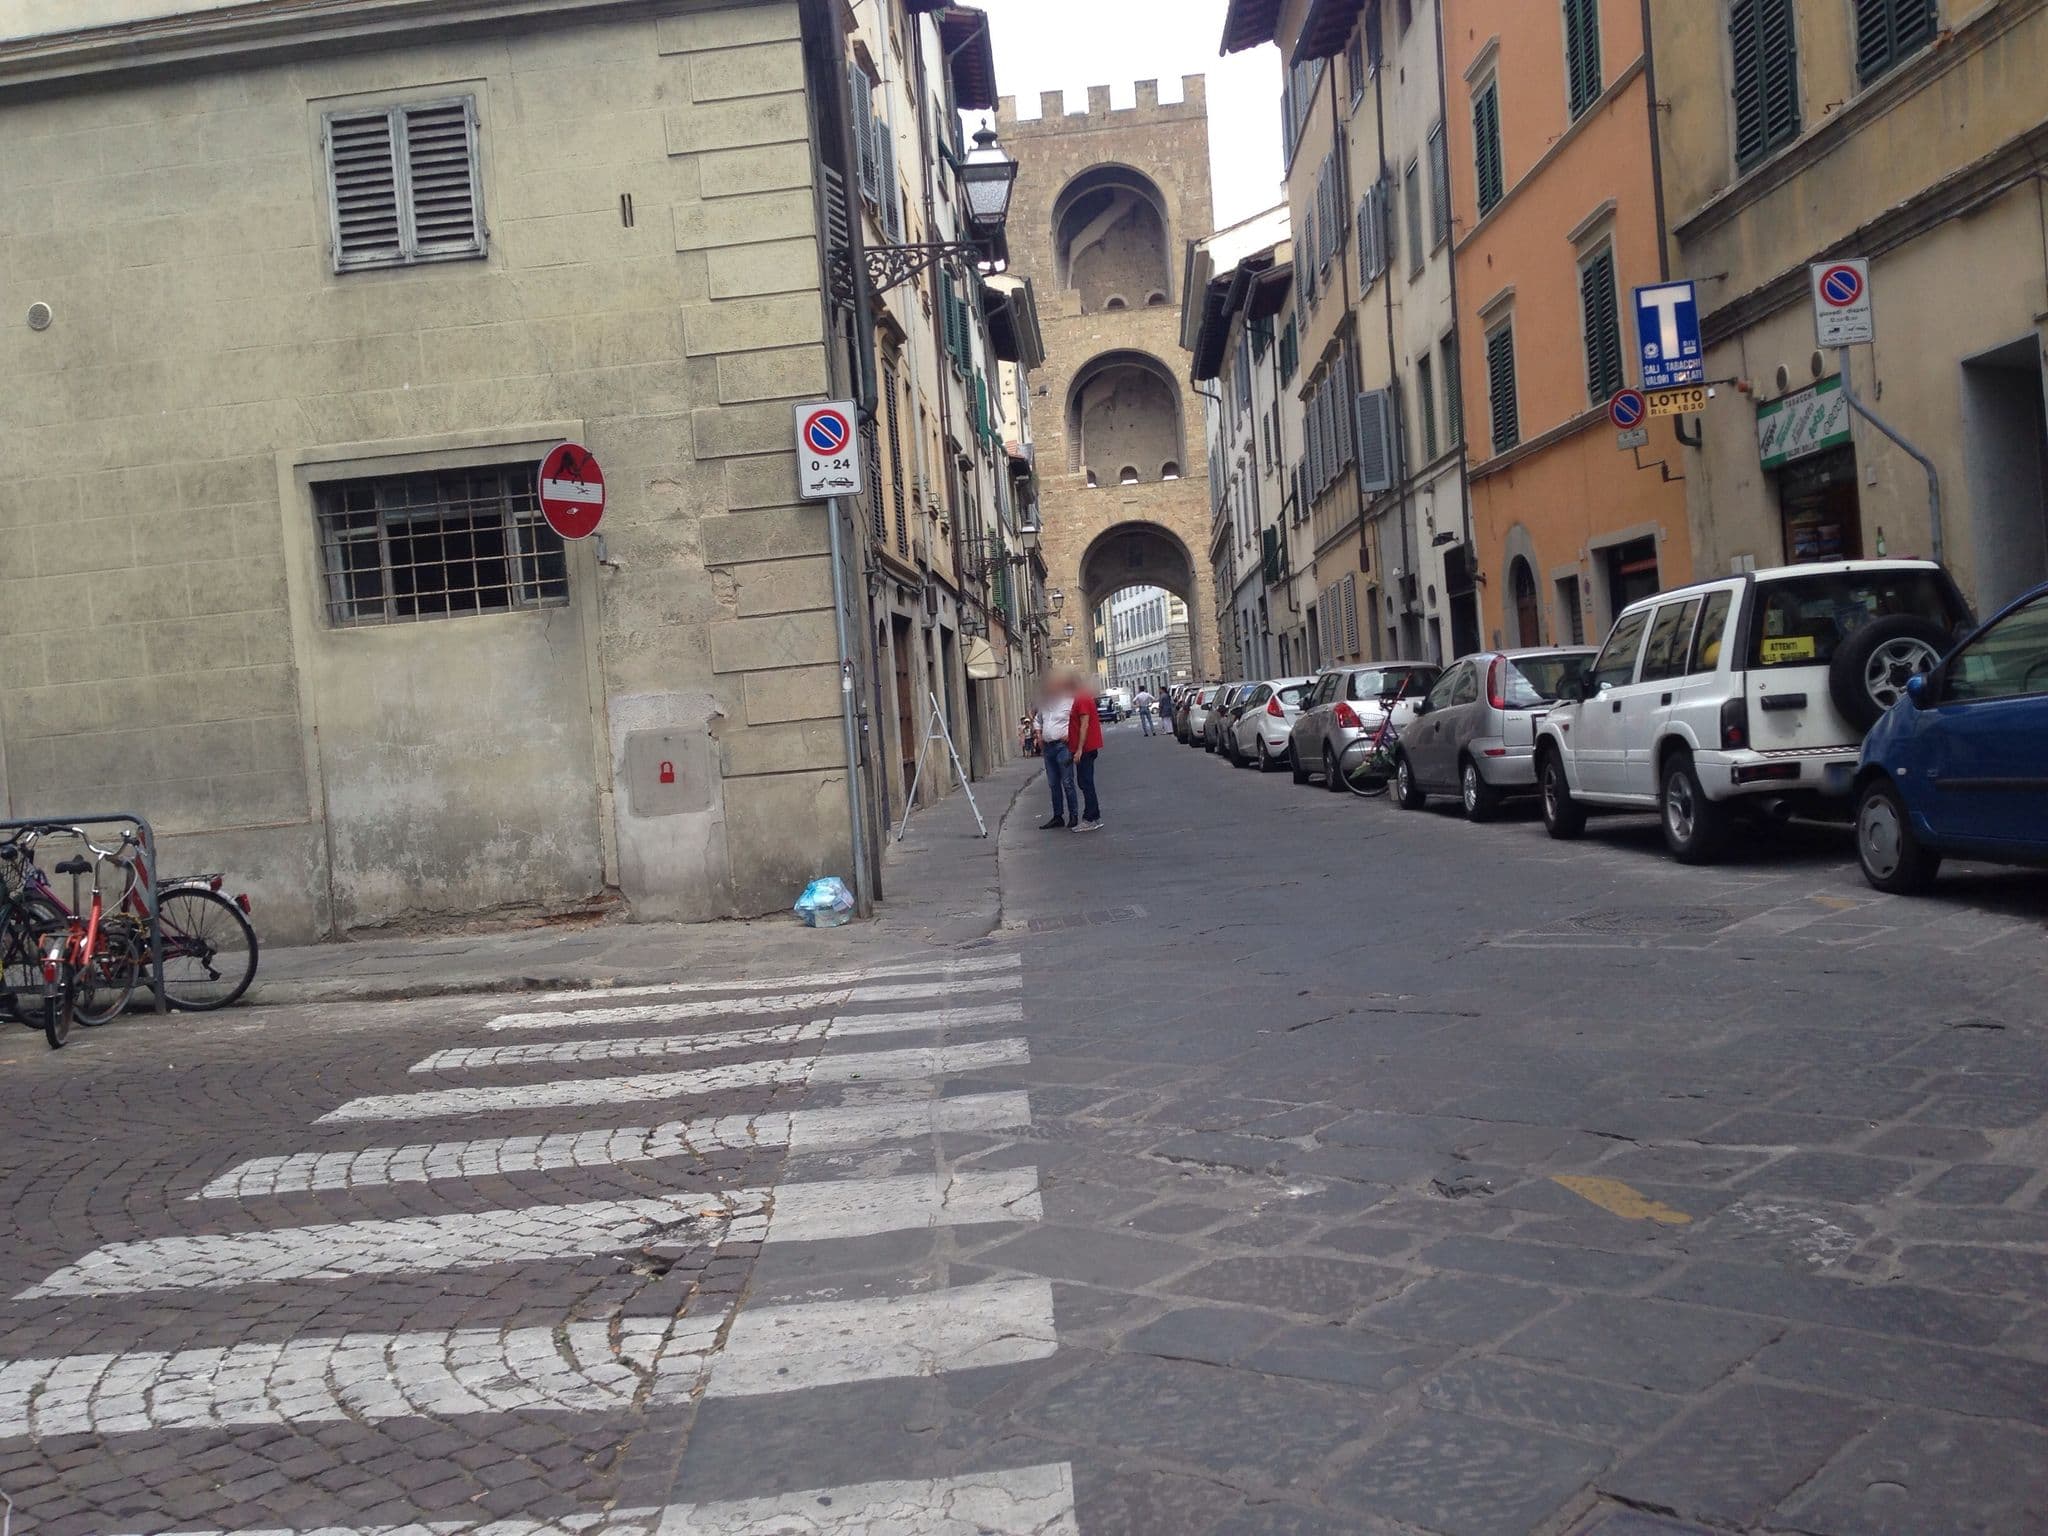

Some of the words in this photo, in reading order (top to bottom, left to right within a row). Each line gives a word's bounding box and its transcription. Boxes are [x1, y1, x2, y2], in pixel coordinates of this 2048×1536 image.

[1640, 285, 1692, 360] T
[1644, 364, 1660, 376] SALI
[1665, 359, 1701, 372] TABACCHI
[1649, 390, 1702, 408] LOTTO
[811, 460, 820, 471] 0
[833, 458, 851, 470] 24
